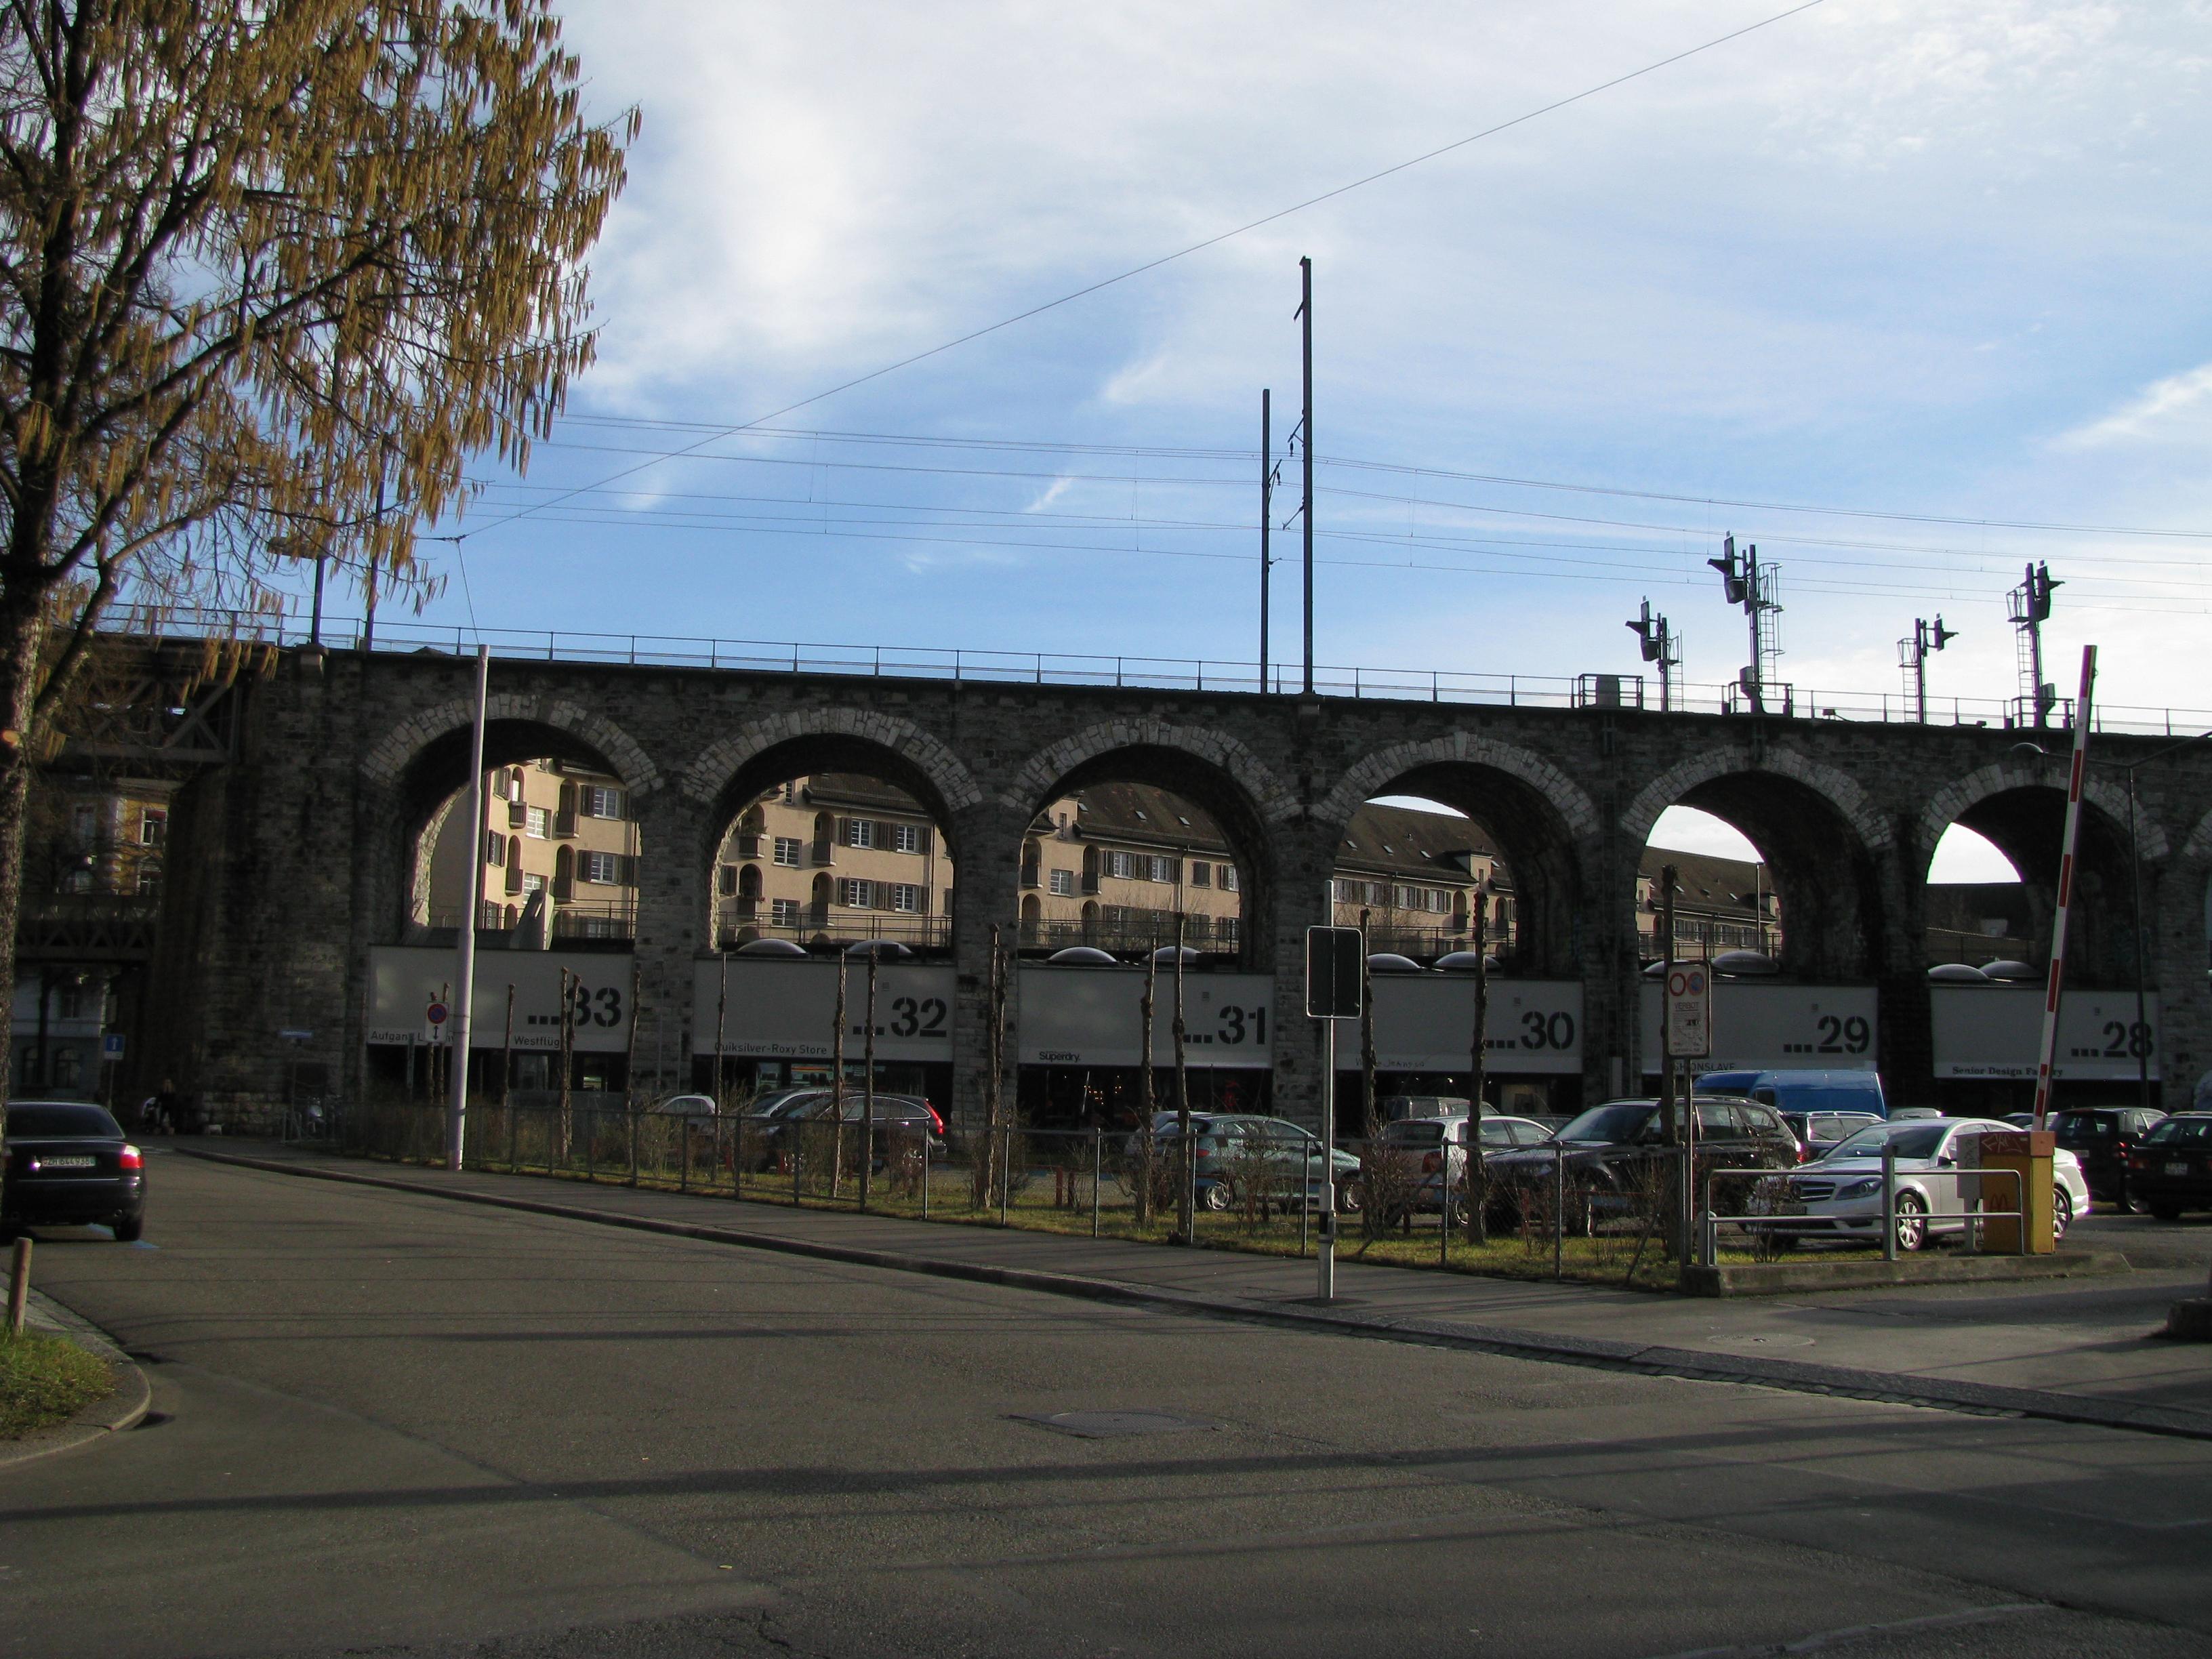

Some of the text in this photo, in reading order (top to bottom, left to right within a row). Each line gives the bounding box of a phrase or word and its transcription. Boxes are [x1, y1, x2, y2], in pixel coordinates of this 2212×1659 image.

[371, 1030, 411, 1043] Aufgan
[515, 1035, 560, 1048] Westflüg
[800, 1044, 827, 1054] Store
[1952, 1066, 2063, 1077] Senior Design Fary
